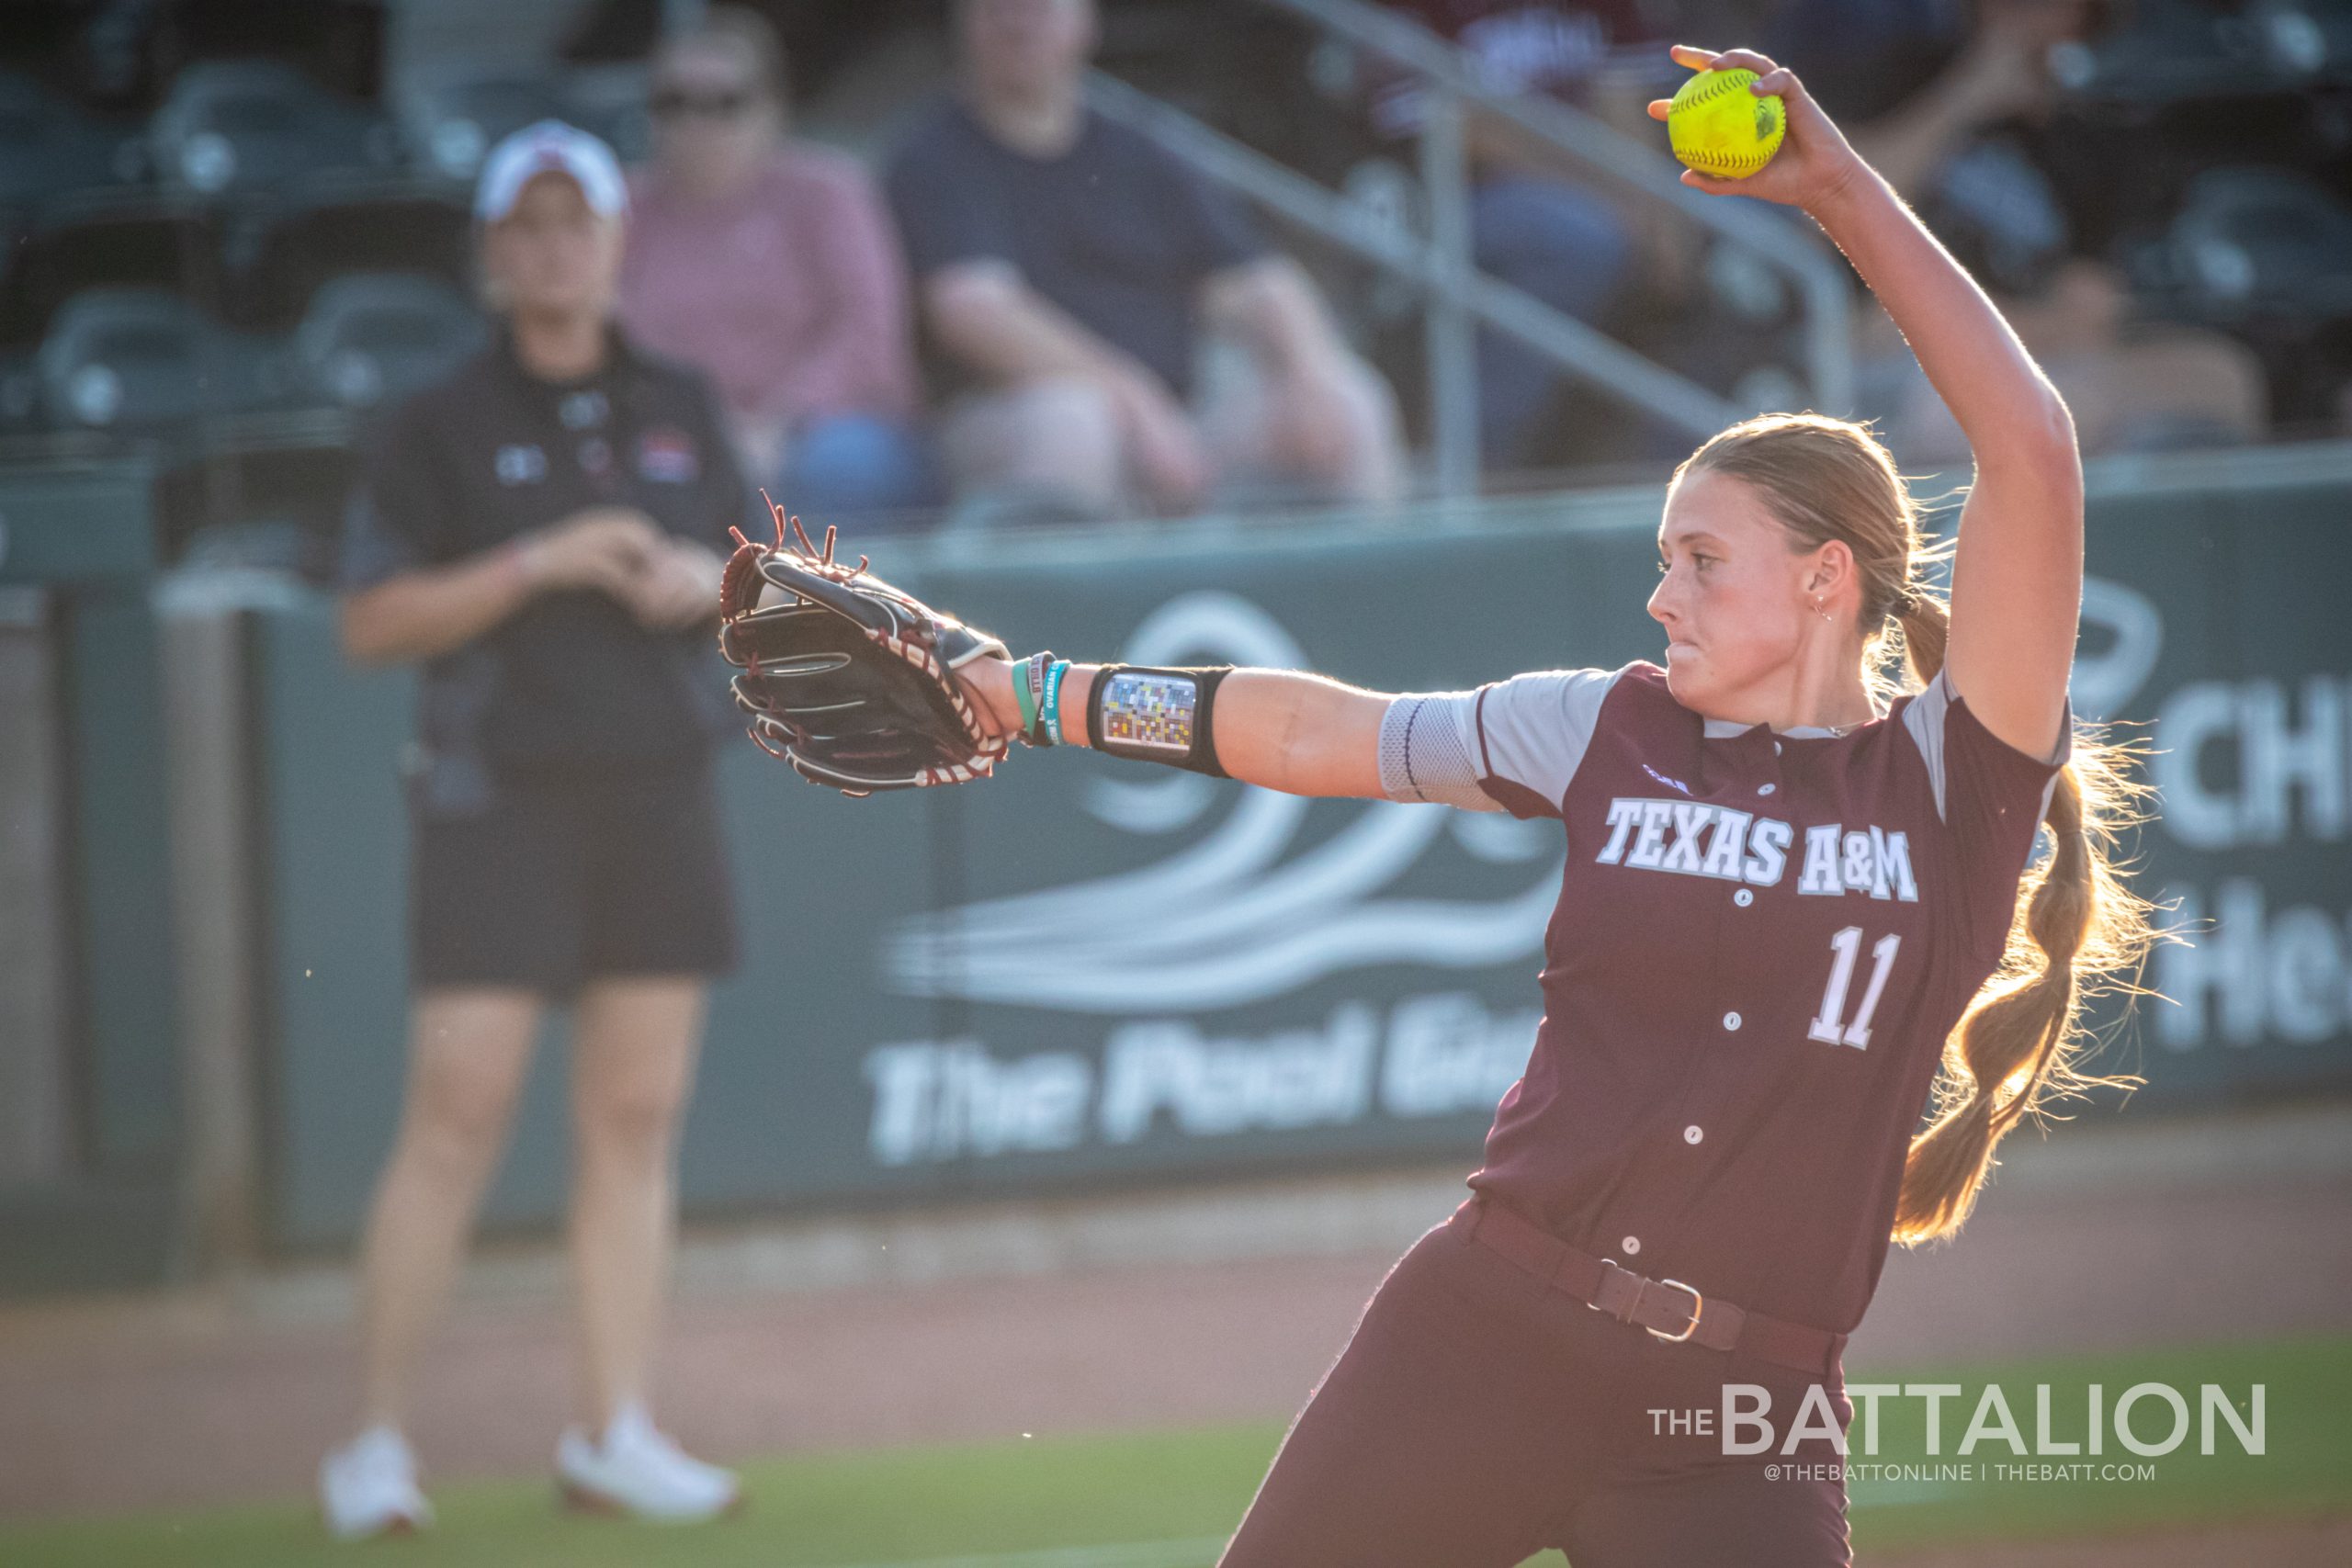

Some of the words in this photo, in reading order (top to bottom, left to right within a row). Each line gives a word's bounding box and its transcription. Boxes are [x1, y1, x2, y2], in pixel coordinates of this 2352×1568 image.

[1046, 671, 1057, 708] OVARIAN
[2157, 678, 2352, 848] CH
[1595, 797, 1793, 886] TEXAS
[1797, 823, 1918, 902] A&M
[1807, 926, 1901, 1050] 11
[2157, 876, 2352, 1051] He
[865, 1038, 1091, 1166] The
[1101, 999, 1378, 1145] Pool
